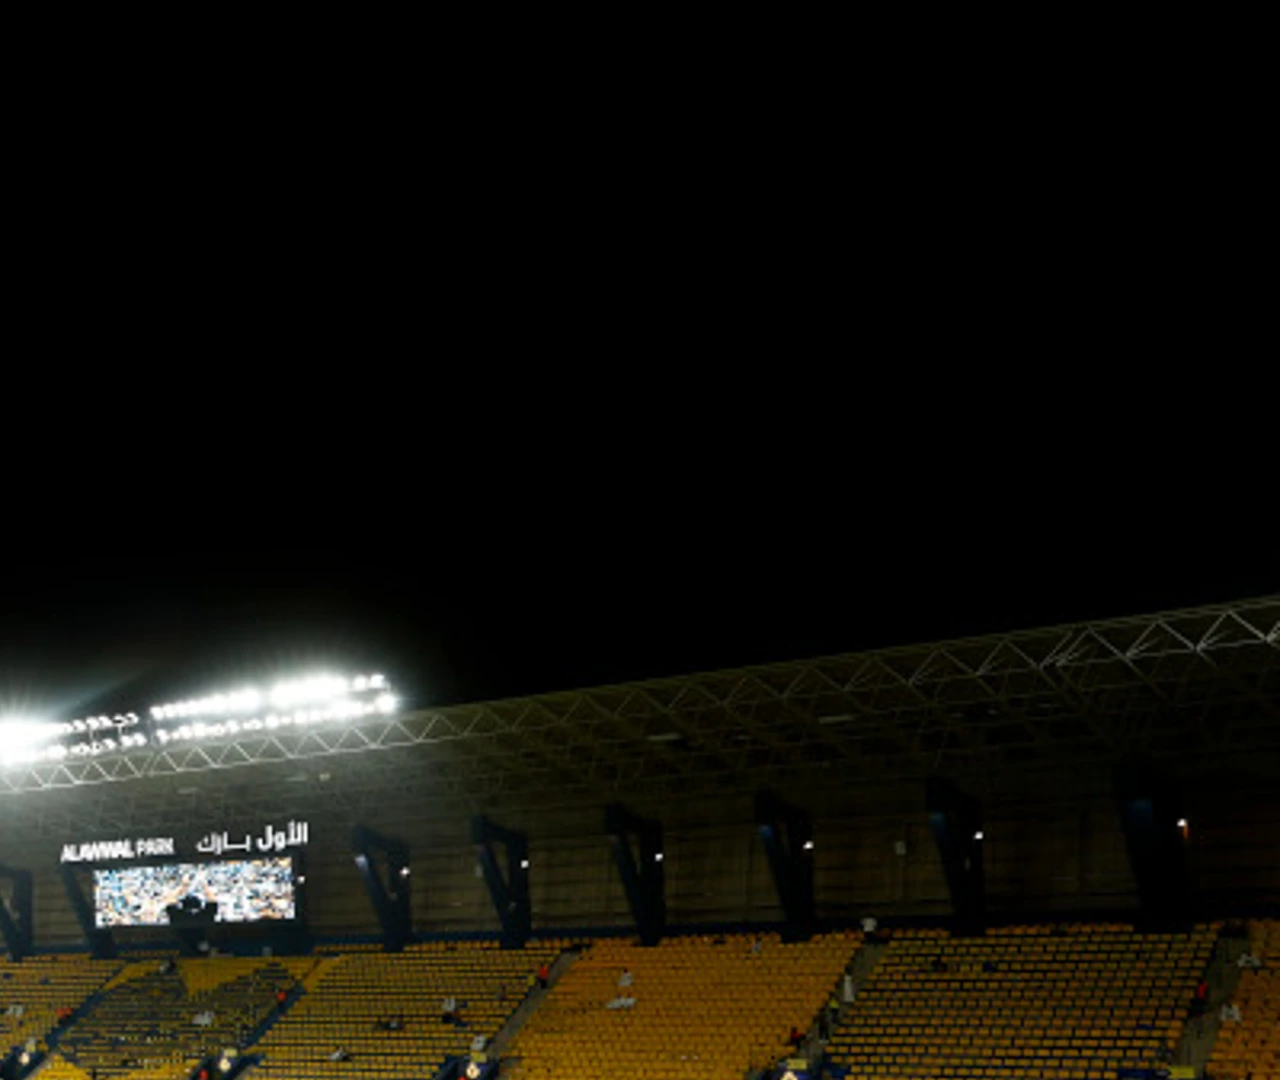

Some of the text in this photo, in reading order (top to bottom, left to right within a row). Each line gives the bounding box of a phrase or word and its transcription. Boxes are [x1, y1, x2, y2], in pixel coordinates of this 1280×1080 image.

[136, 837, 175, 856] PARK
[196, 819, 309, 855] الأول بارك
